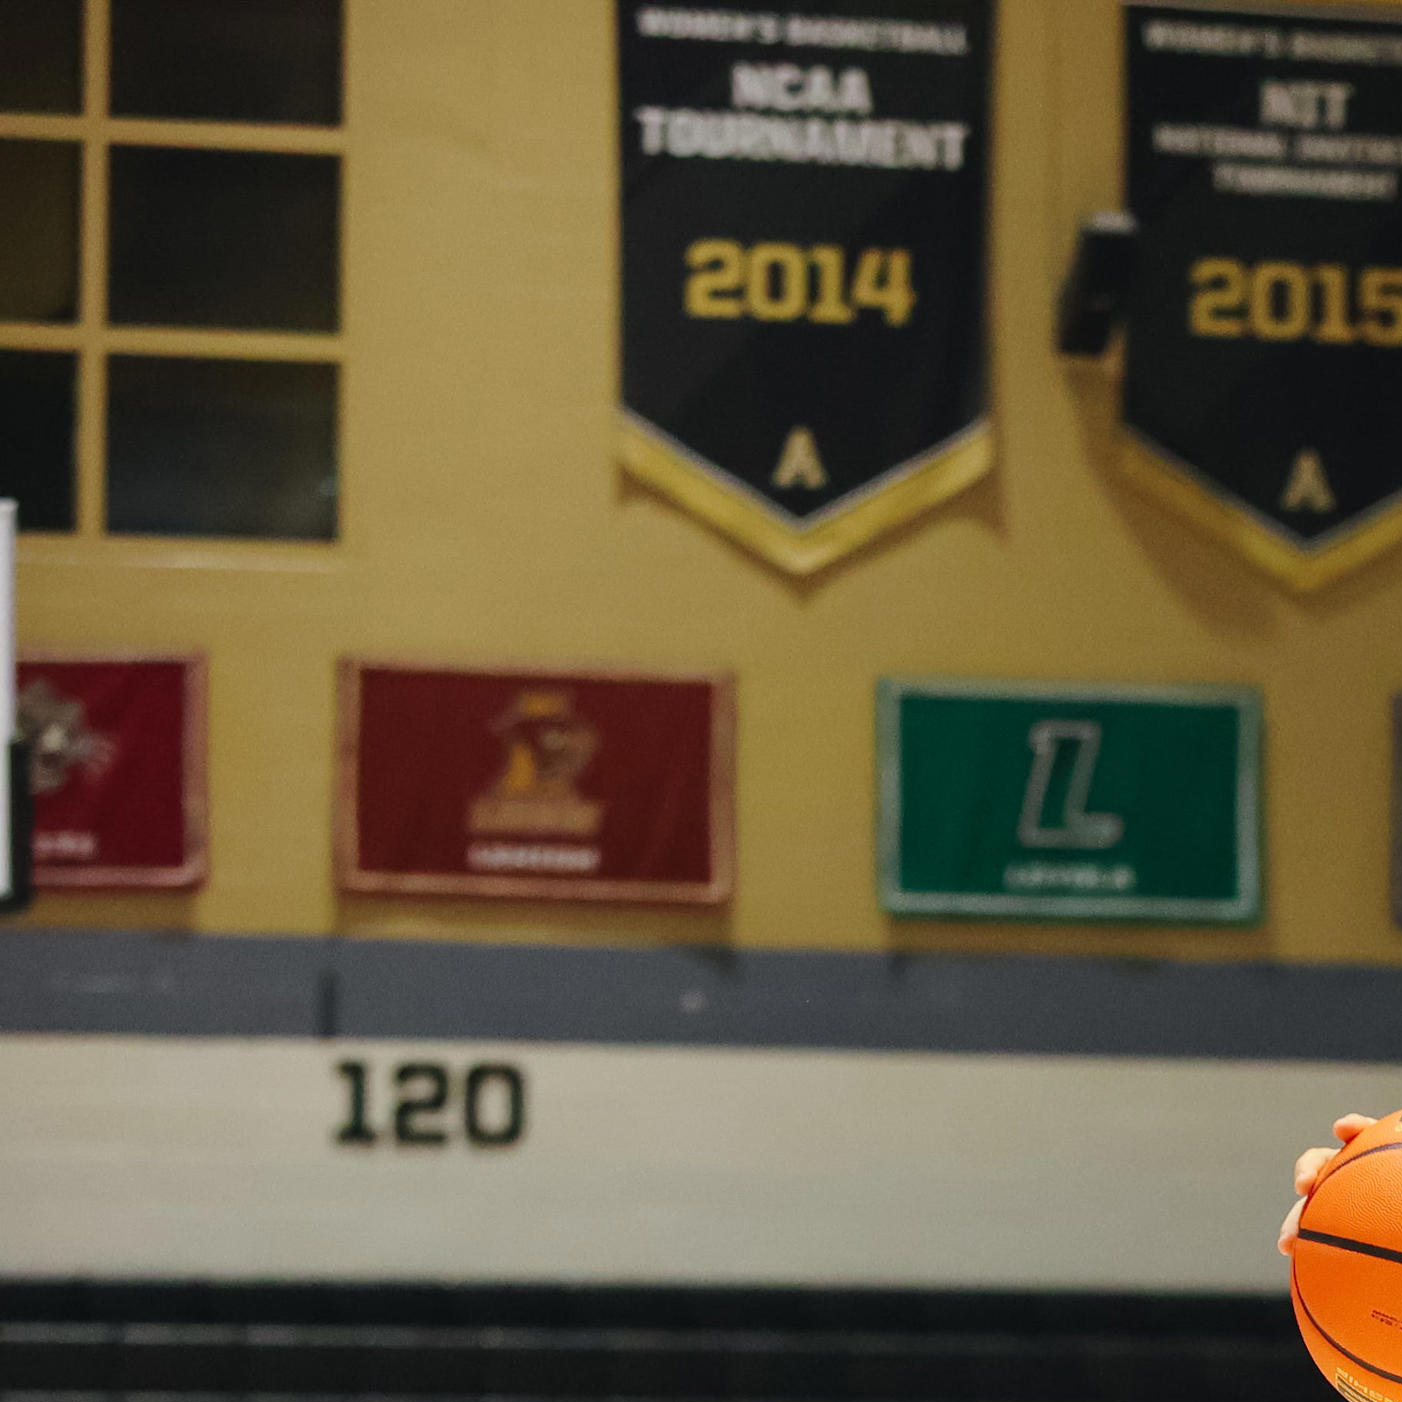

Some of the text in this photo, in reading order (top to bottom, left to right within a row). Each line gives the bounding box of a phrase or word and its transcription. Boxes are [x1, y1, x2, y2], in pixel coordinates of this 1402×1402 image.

[731, 61, 872, 114] NCAA
[634, 106, 970, 171] TOURNAMENT
[684, 238, 916, 327] 2014
[772, 425, 829, 490] A
[1279, 447, 1338, 512] A
[1017, 719, 1126, 849] L
[333, 1057, 528, 1149] 120
